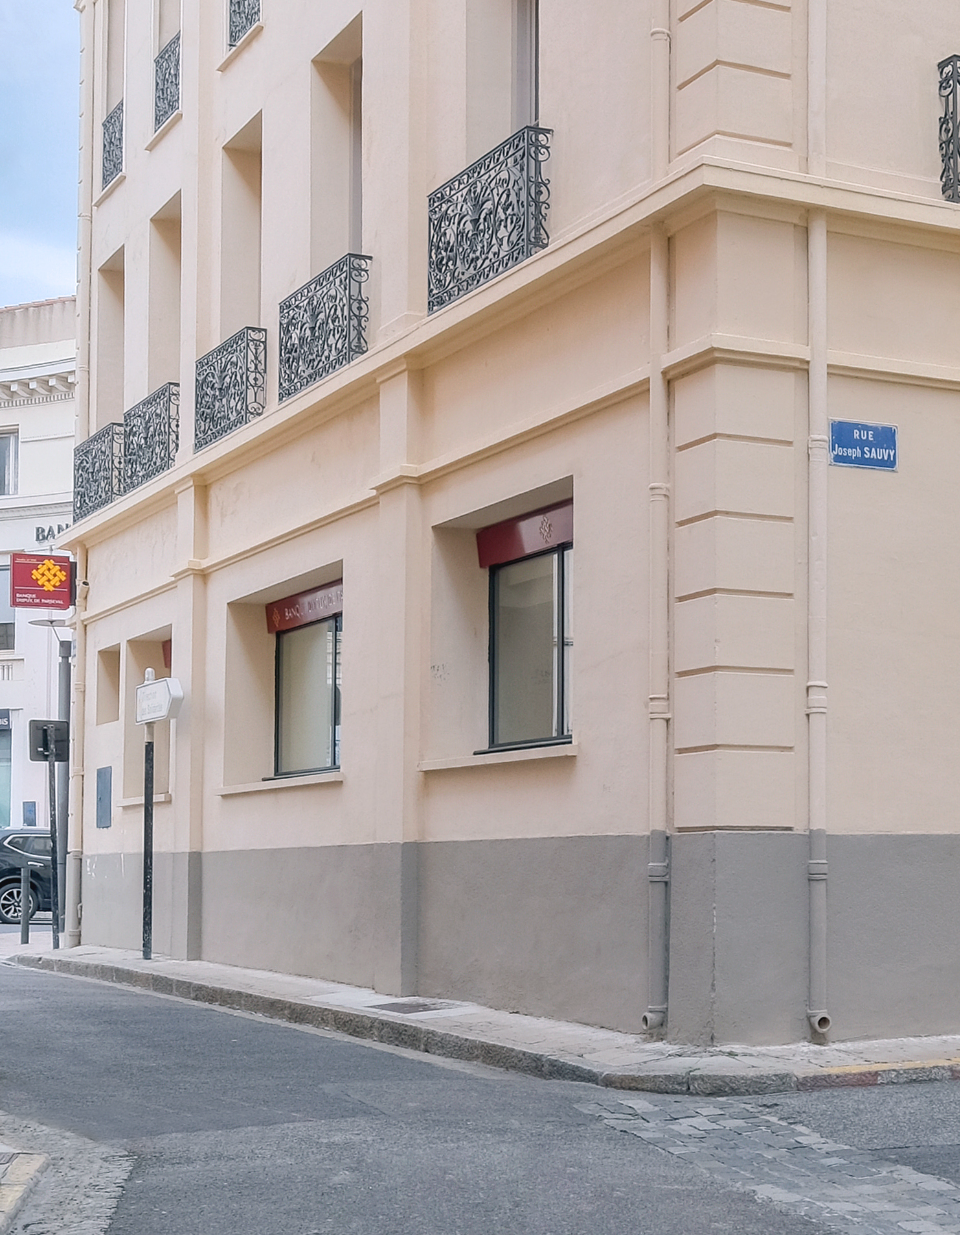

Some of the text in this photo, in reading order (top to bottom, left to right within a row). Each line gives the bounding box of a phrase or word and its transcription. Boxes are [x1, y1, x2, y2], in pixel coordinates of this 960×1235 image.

[853, 429, 874, 441] RUE
[833, 443, 895, 462] Joseph SAUVY
